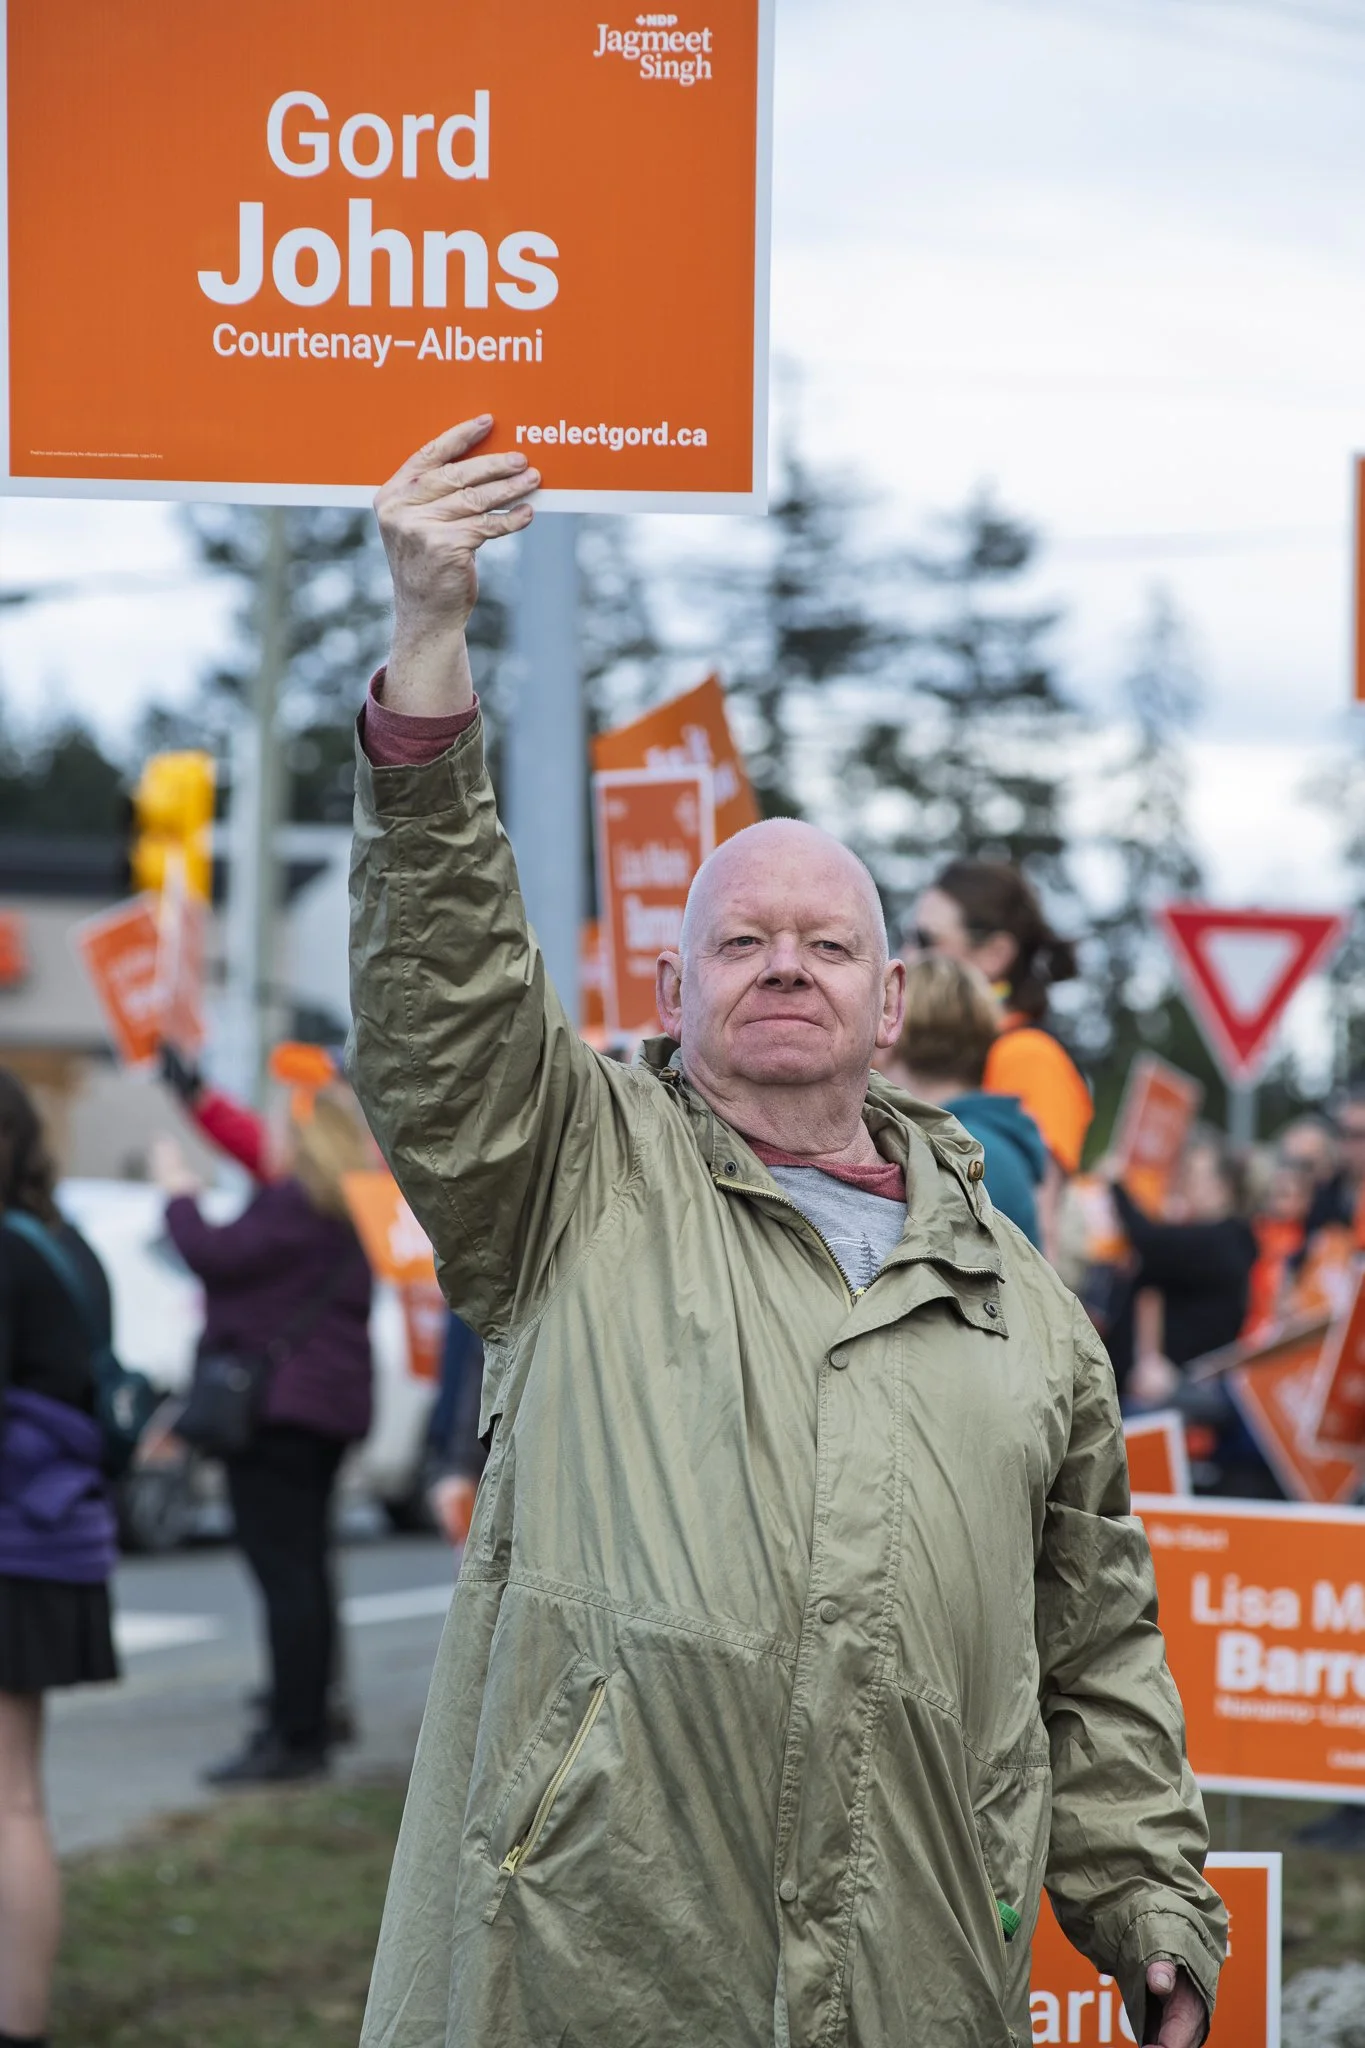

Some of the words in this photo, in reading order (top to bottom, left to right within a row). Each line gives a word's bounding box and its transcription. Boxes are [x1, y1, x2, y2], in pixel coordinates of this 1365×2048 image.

[646, 14, 678, 26] NDP
[593, 23, 713, 60] Jagmeet
[639, 53, 713, 86] Singh
[266, 89, 491, 180] Gord
[197, 197, 560, 310] Johns
[515, 420, 708, 451] reelectgord.ca
[1192, 1574, 1300, 1629] Lisa
[1312, 1580, 1365, 1632] M
